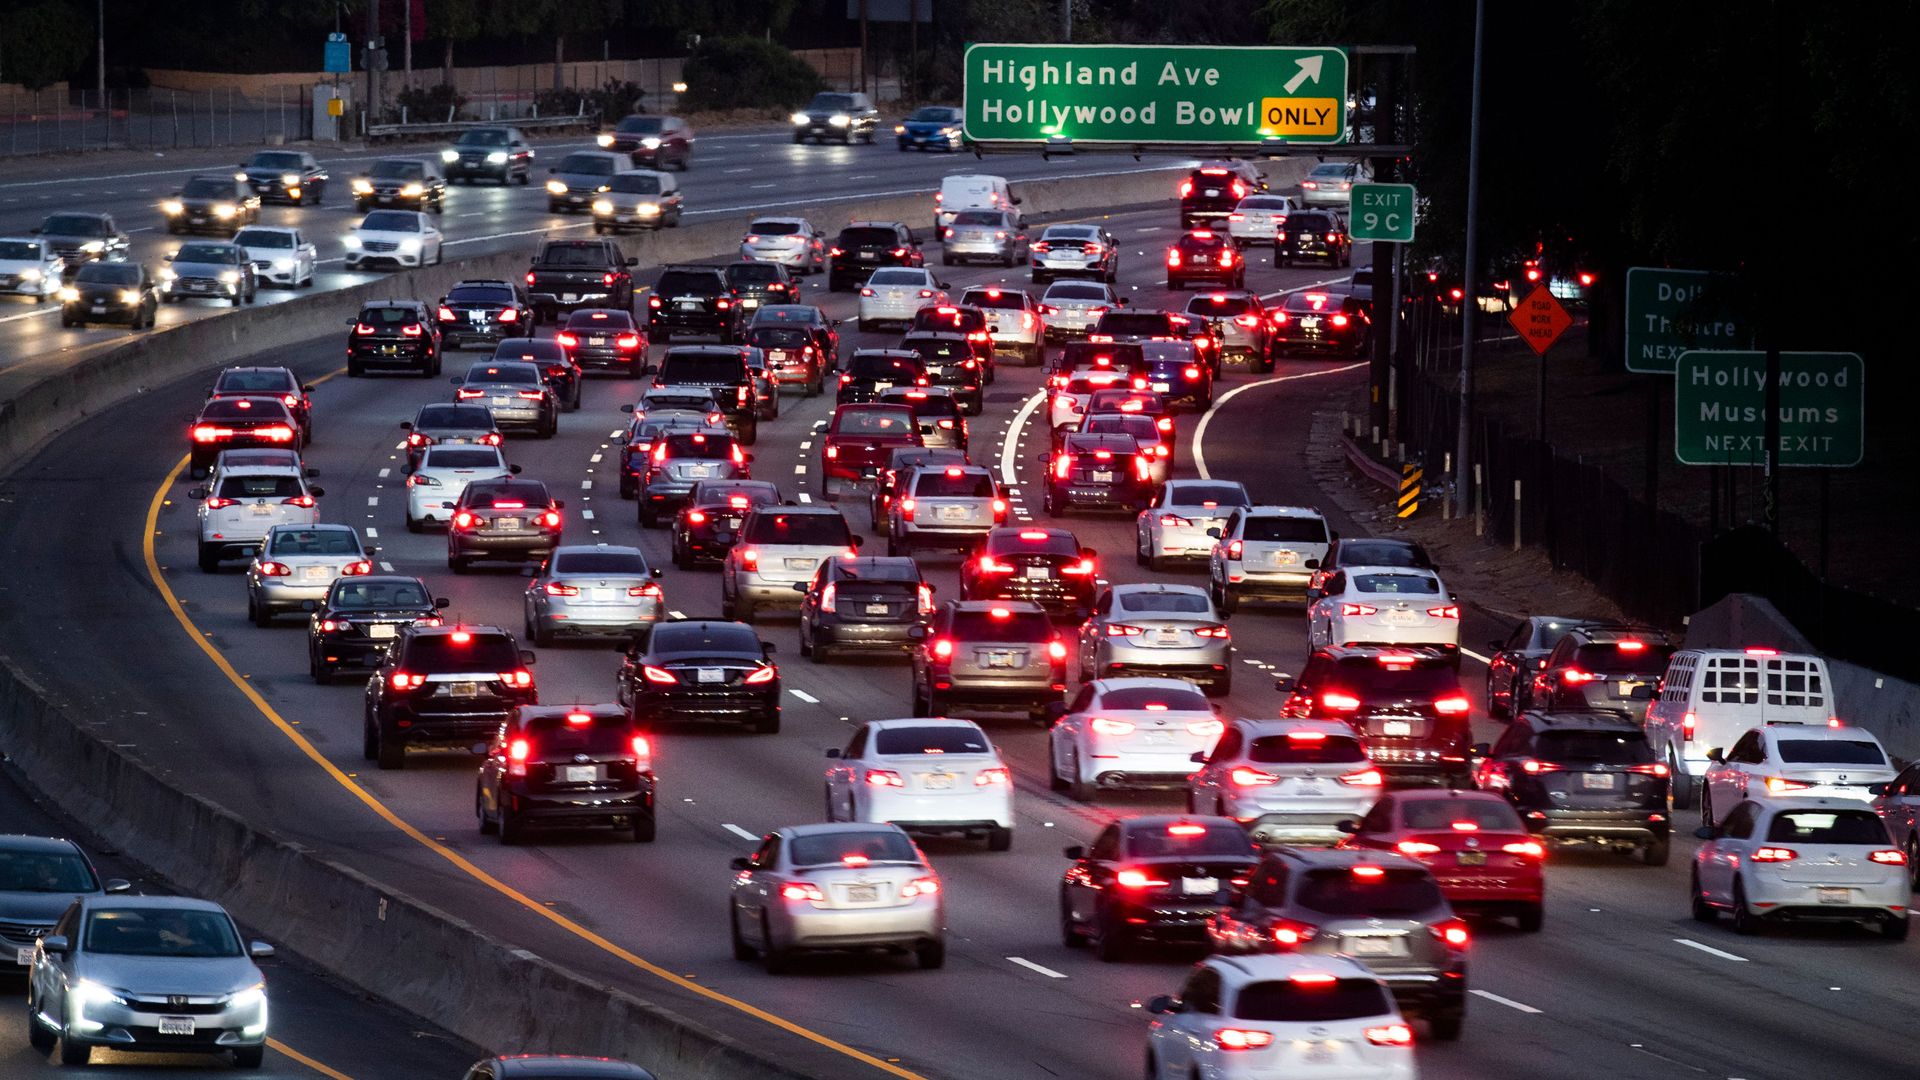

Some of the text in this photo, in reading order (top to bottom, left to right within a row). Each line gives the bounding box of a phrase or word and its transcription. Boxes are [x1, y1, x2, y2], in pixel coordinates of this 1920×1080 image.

[982, 59, 1221, 92] Highland Ave
[981, 99, 1255, 129] Hollywood Bowl
[1267, 106, 1331, 127] ONLY
[1363, 192, 1401, 207] EXIT
[1531, 300, 1552, 311] ROAD
[1530, 314, 1551, 324] WORK
[1528, 327, 1553, 338] AHEAD
[1642, 344, 1687, 360] NEX
[1692, 365, 1848, 392] Hollywood
[1700, 402, 1839, 424] Musums
[1705, 435, 1833, 452] NEXT EXIT
